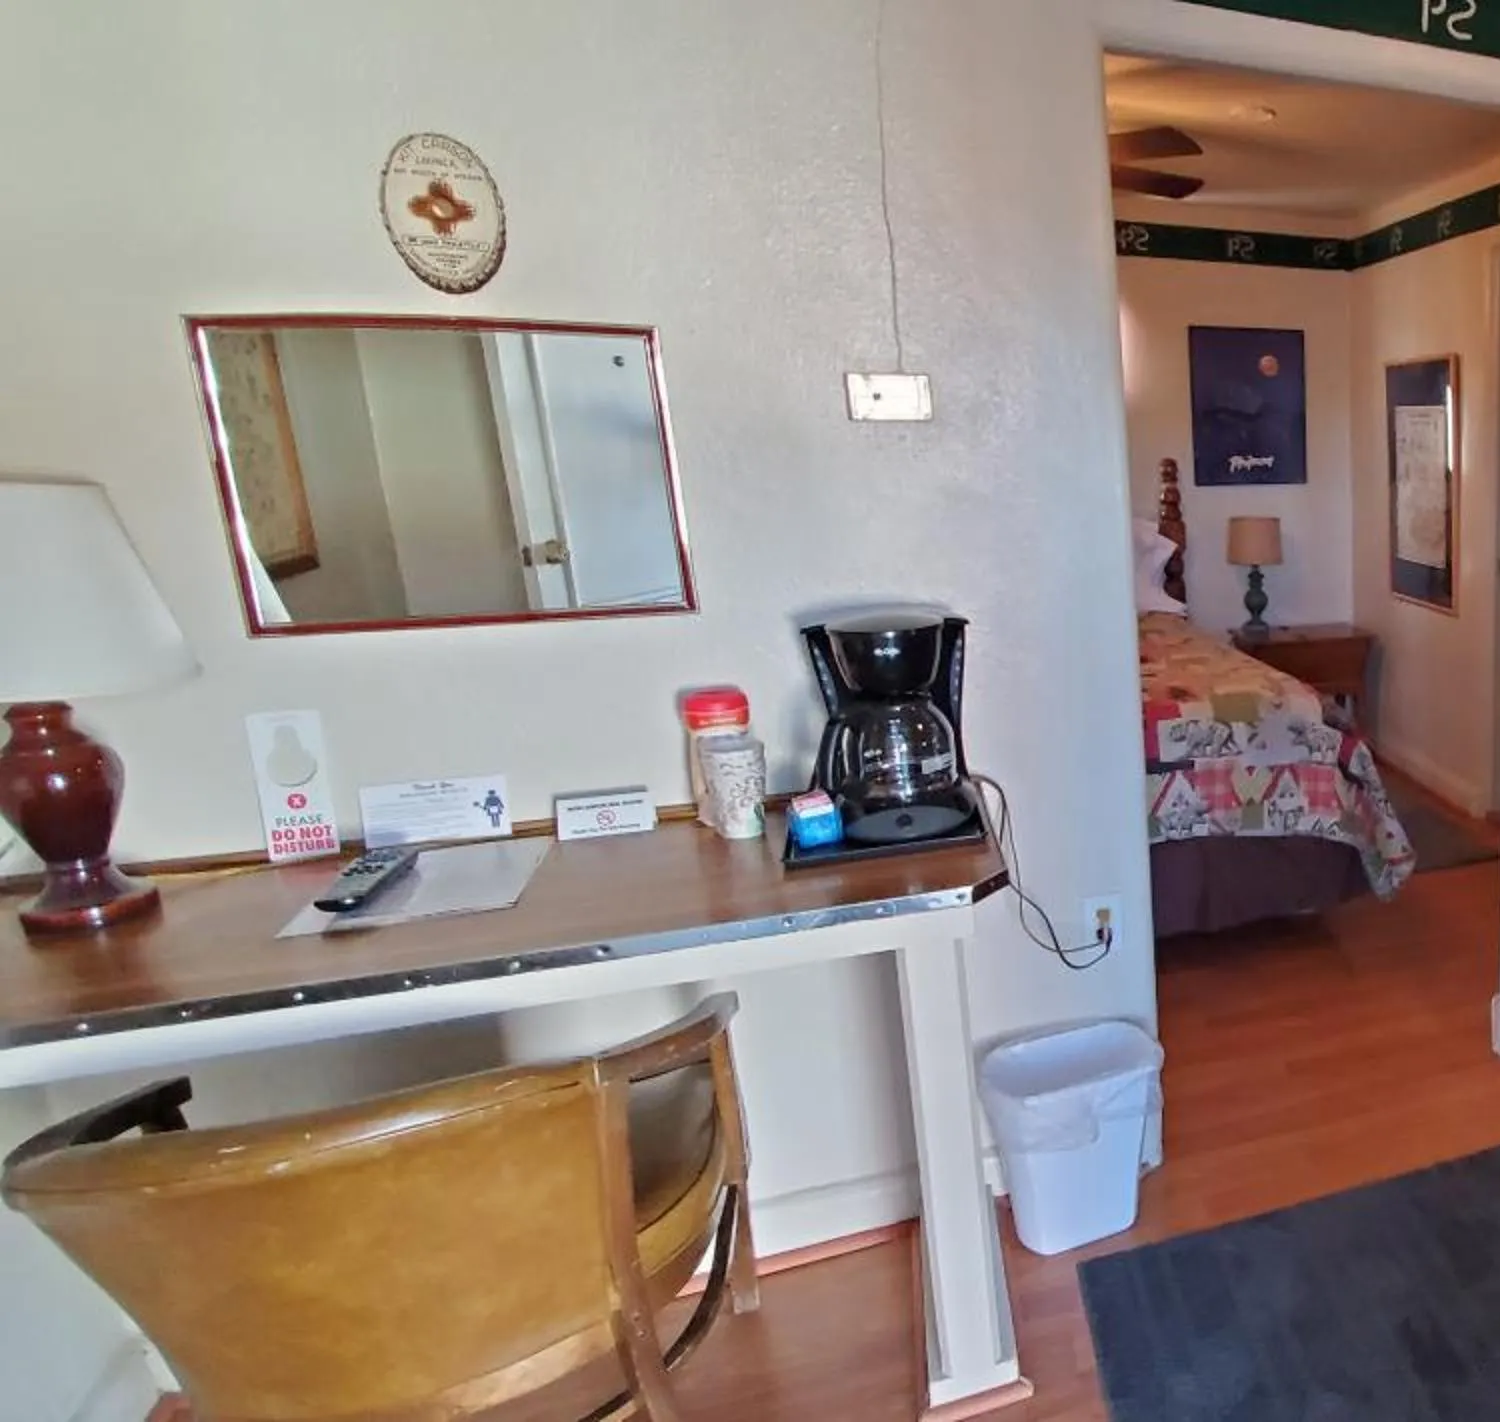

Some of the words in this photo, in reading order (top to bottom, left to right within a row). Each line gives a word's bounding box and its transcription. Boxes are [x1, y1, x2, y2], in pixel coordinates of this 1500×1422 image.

[275, 813, 323, 828] PLEASE
[271, 829, 295, 842] DO
[300, 824, 333, 840] NOT
[273, 838, 335, 854] DISTURB
